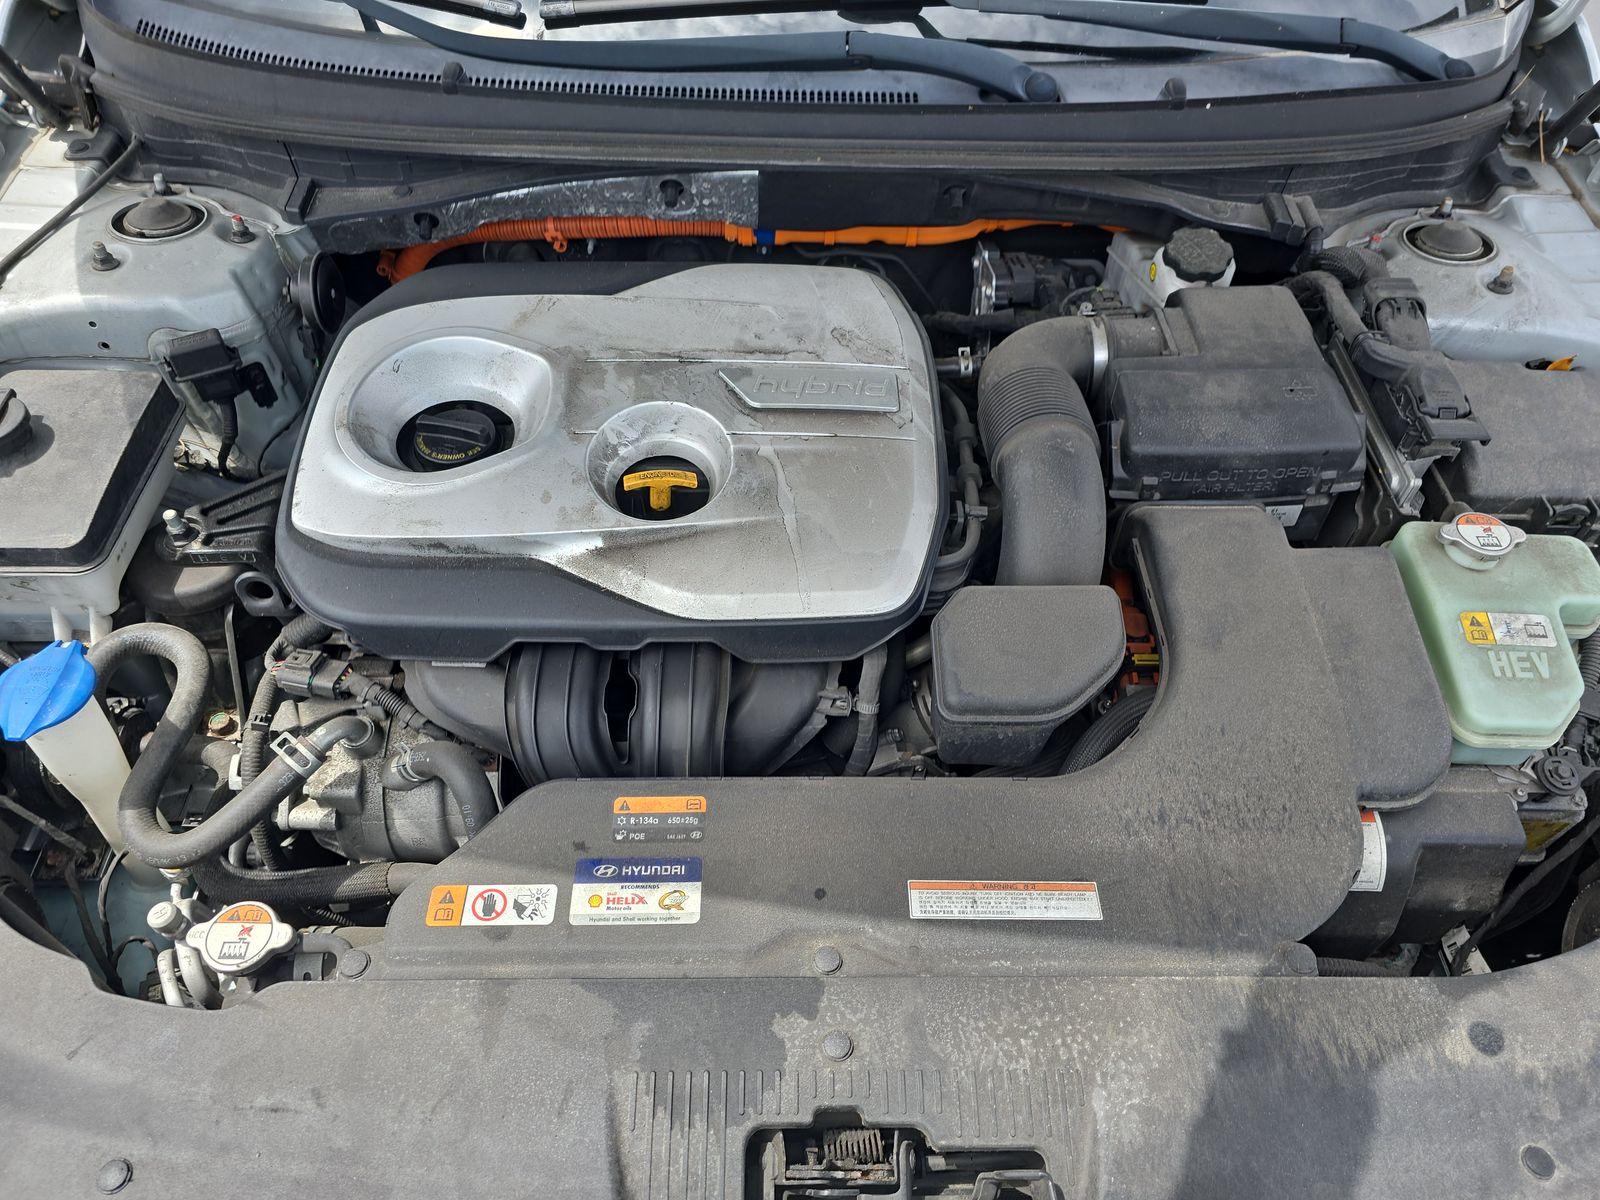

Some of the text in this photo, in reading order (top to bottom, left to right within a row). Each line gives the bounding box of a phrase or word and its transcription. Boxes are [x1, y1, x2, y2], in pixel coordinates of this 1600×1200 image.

[752, 374, 889, 399] hybrid
[1159, 466, 1321, 482] PULL OUT TO OPEN
[1487, 649, 1551, 679] HEV
[630, 817, 659, 825] R-134a
[622, 865, 685, 876] HYUNDAI
[606, 896, 647, 905] HELIX
[637, 915, 658, 923] working
